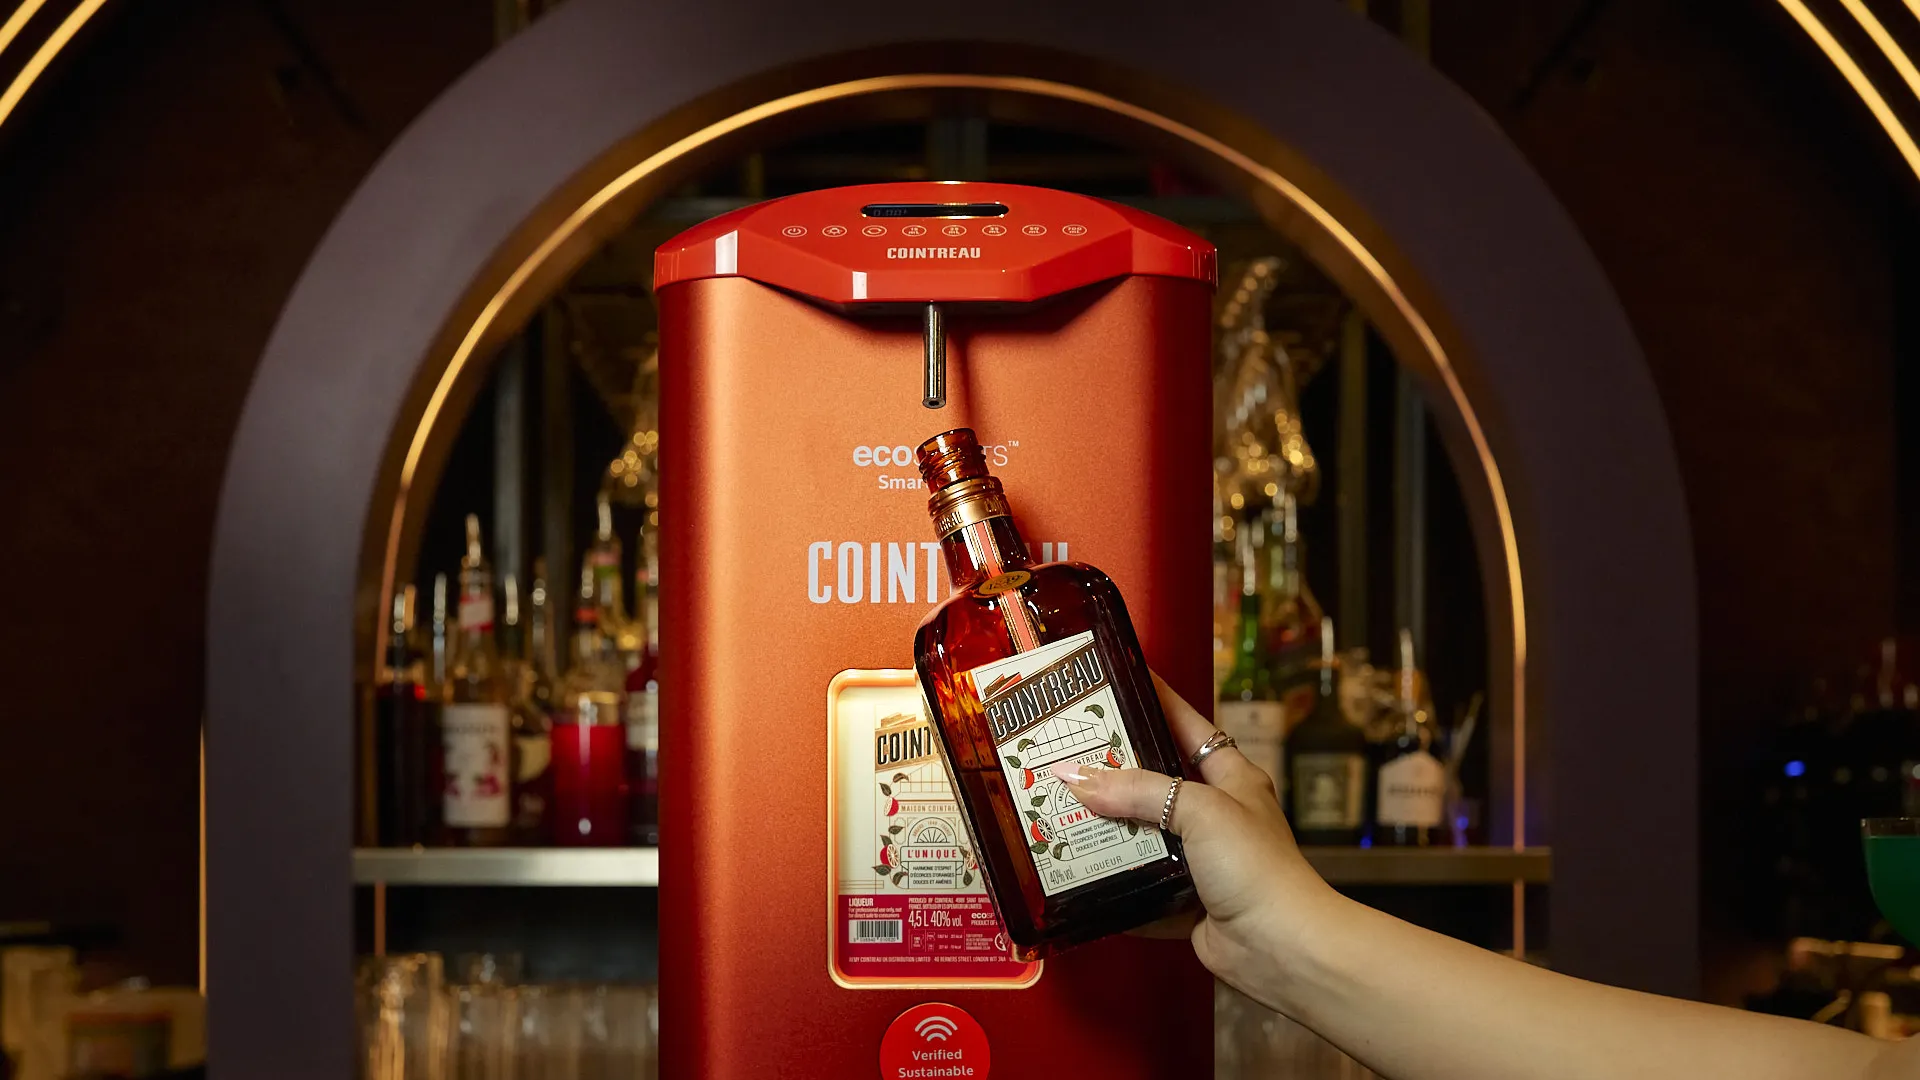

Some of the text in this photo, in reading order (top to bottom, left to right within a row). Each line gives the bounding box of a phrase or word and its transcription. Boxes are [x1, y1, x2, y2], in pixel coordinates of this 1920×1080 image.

[887, 247, 981, 259] COINTREAU
[878, 475, 929, 490] Smar
[986, 648, 1104, 740] COINTREAU
[878, 726, 932, 765] COINT
[907, 849, 957, 859] L'UNIQUE
[1084, 855, 1123, 874] LIQUEUR
[848, 898, 874, 907] LIQUEUR
[908, 910, 922, 928] 4,5
[930, 910, 951, 927] 40%
[912, 1049, 962, 1061] Verified
[898, 1065, 974, 1078] Sustainable
